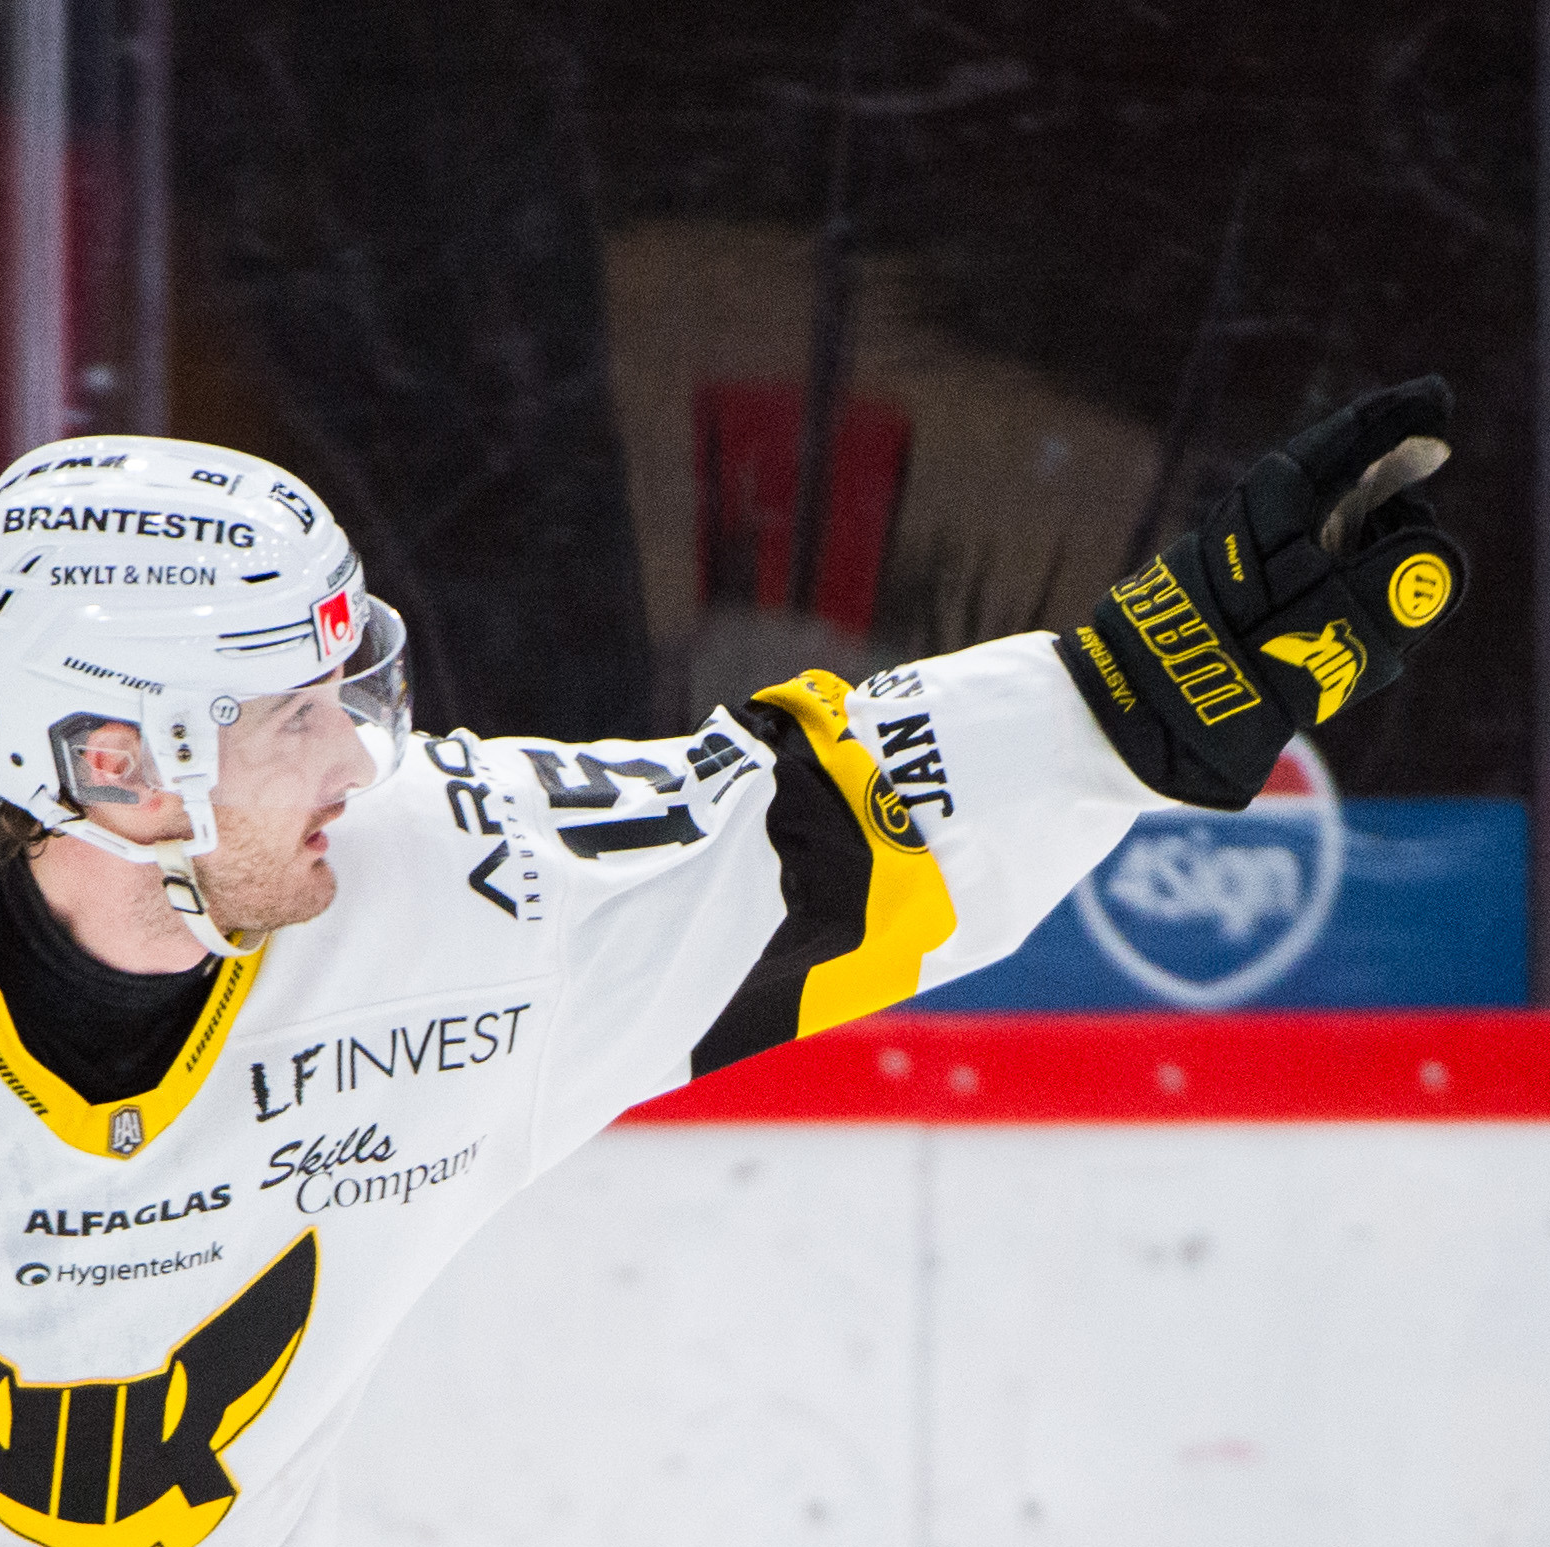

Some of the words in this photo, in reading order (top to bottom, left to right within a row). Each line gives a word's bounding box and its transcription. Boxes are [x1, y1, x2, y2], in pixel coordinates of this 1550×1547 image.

[2, 506, 255, 549] BRANTESTIG
[50, 565, 114, 588] SKYLT
[123, 566, 140, 586] &
[146, 566, 216, 587] NEON
[518, 747, 709, 861] 15
[259, 1123, 397, 1190] Skills
[295, 1135, 487, 1215] Company
[24, 1184, 232, 1237] ALFAGLAS
[57, 1242, 224, 1287] Hygienteknik
